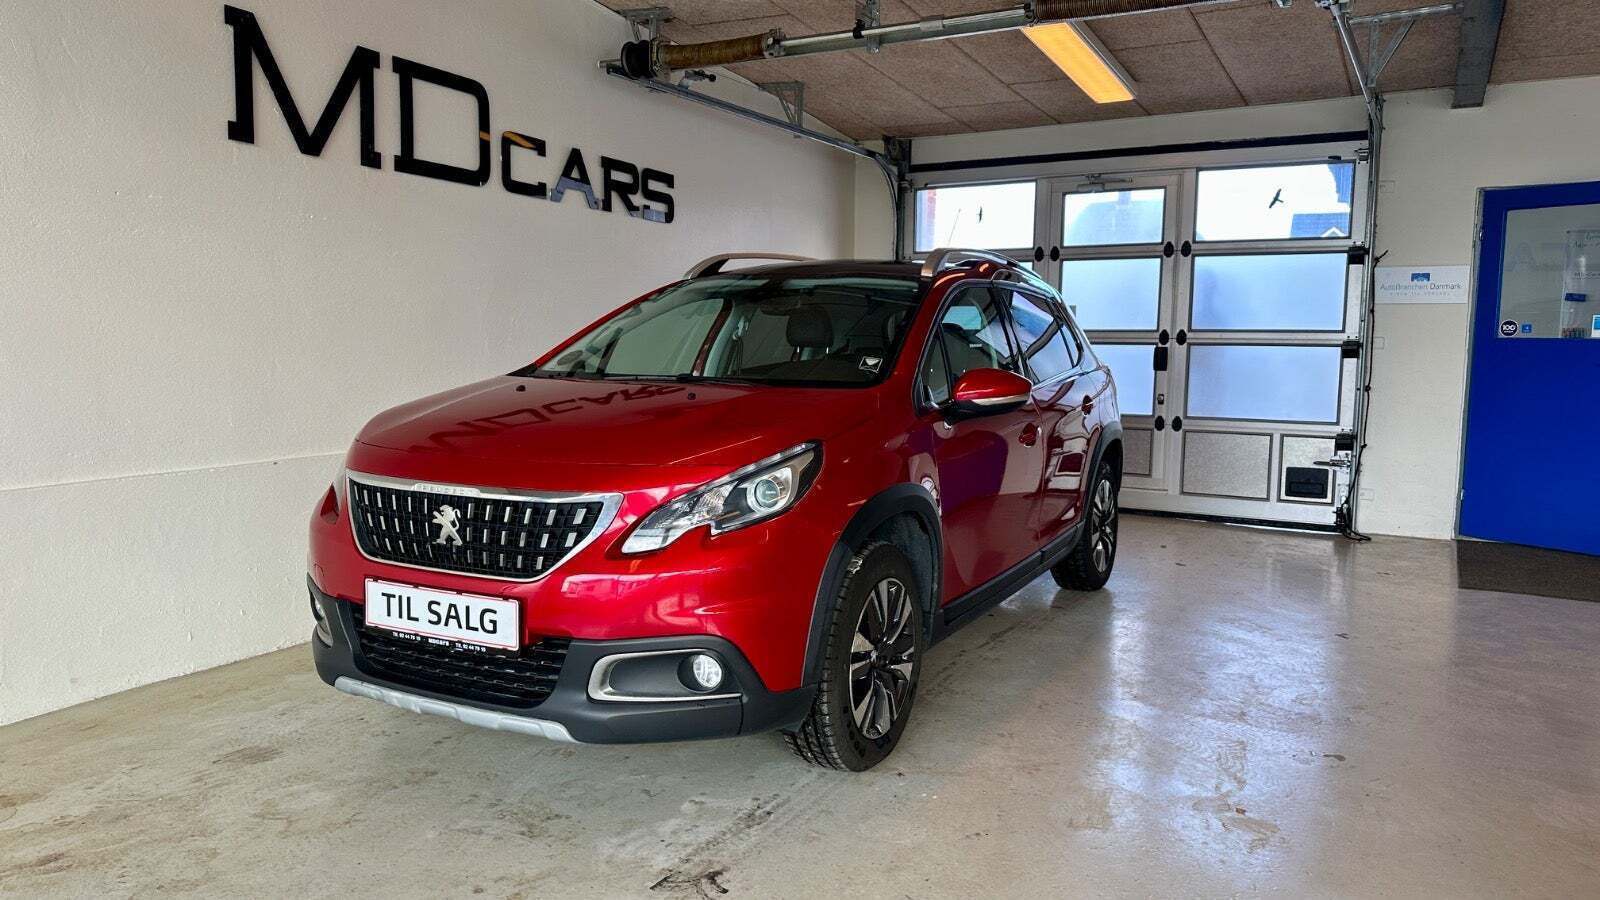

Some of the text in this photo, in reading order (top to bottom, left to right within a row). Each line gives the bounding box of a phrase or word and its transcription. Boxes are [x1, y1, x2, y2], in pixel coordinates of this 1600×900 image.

[1429, 282, 1462, 290] Danmark
[381, 592, 498, 634] TIL SALG
